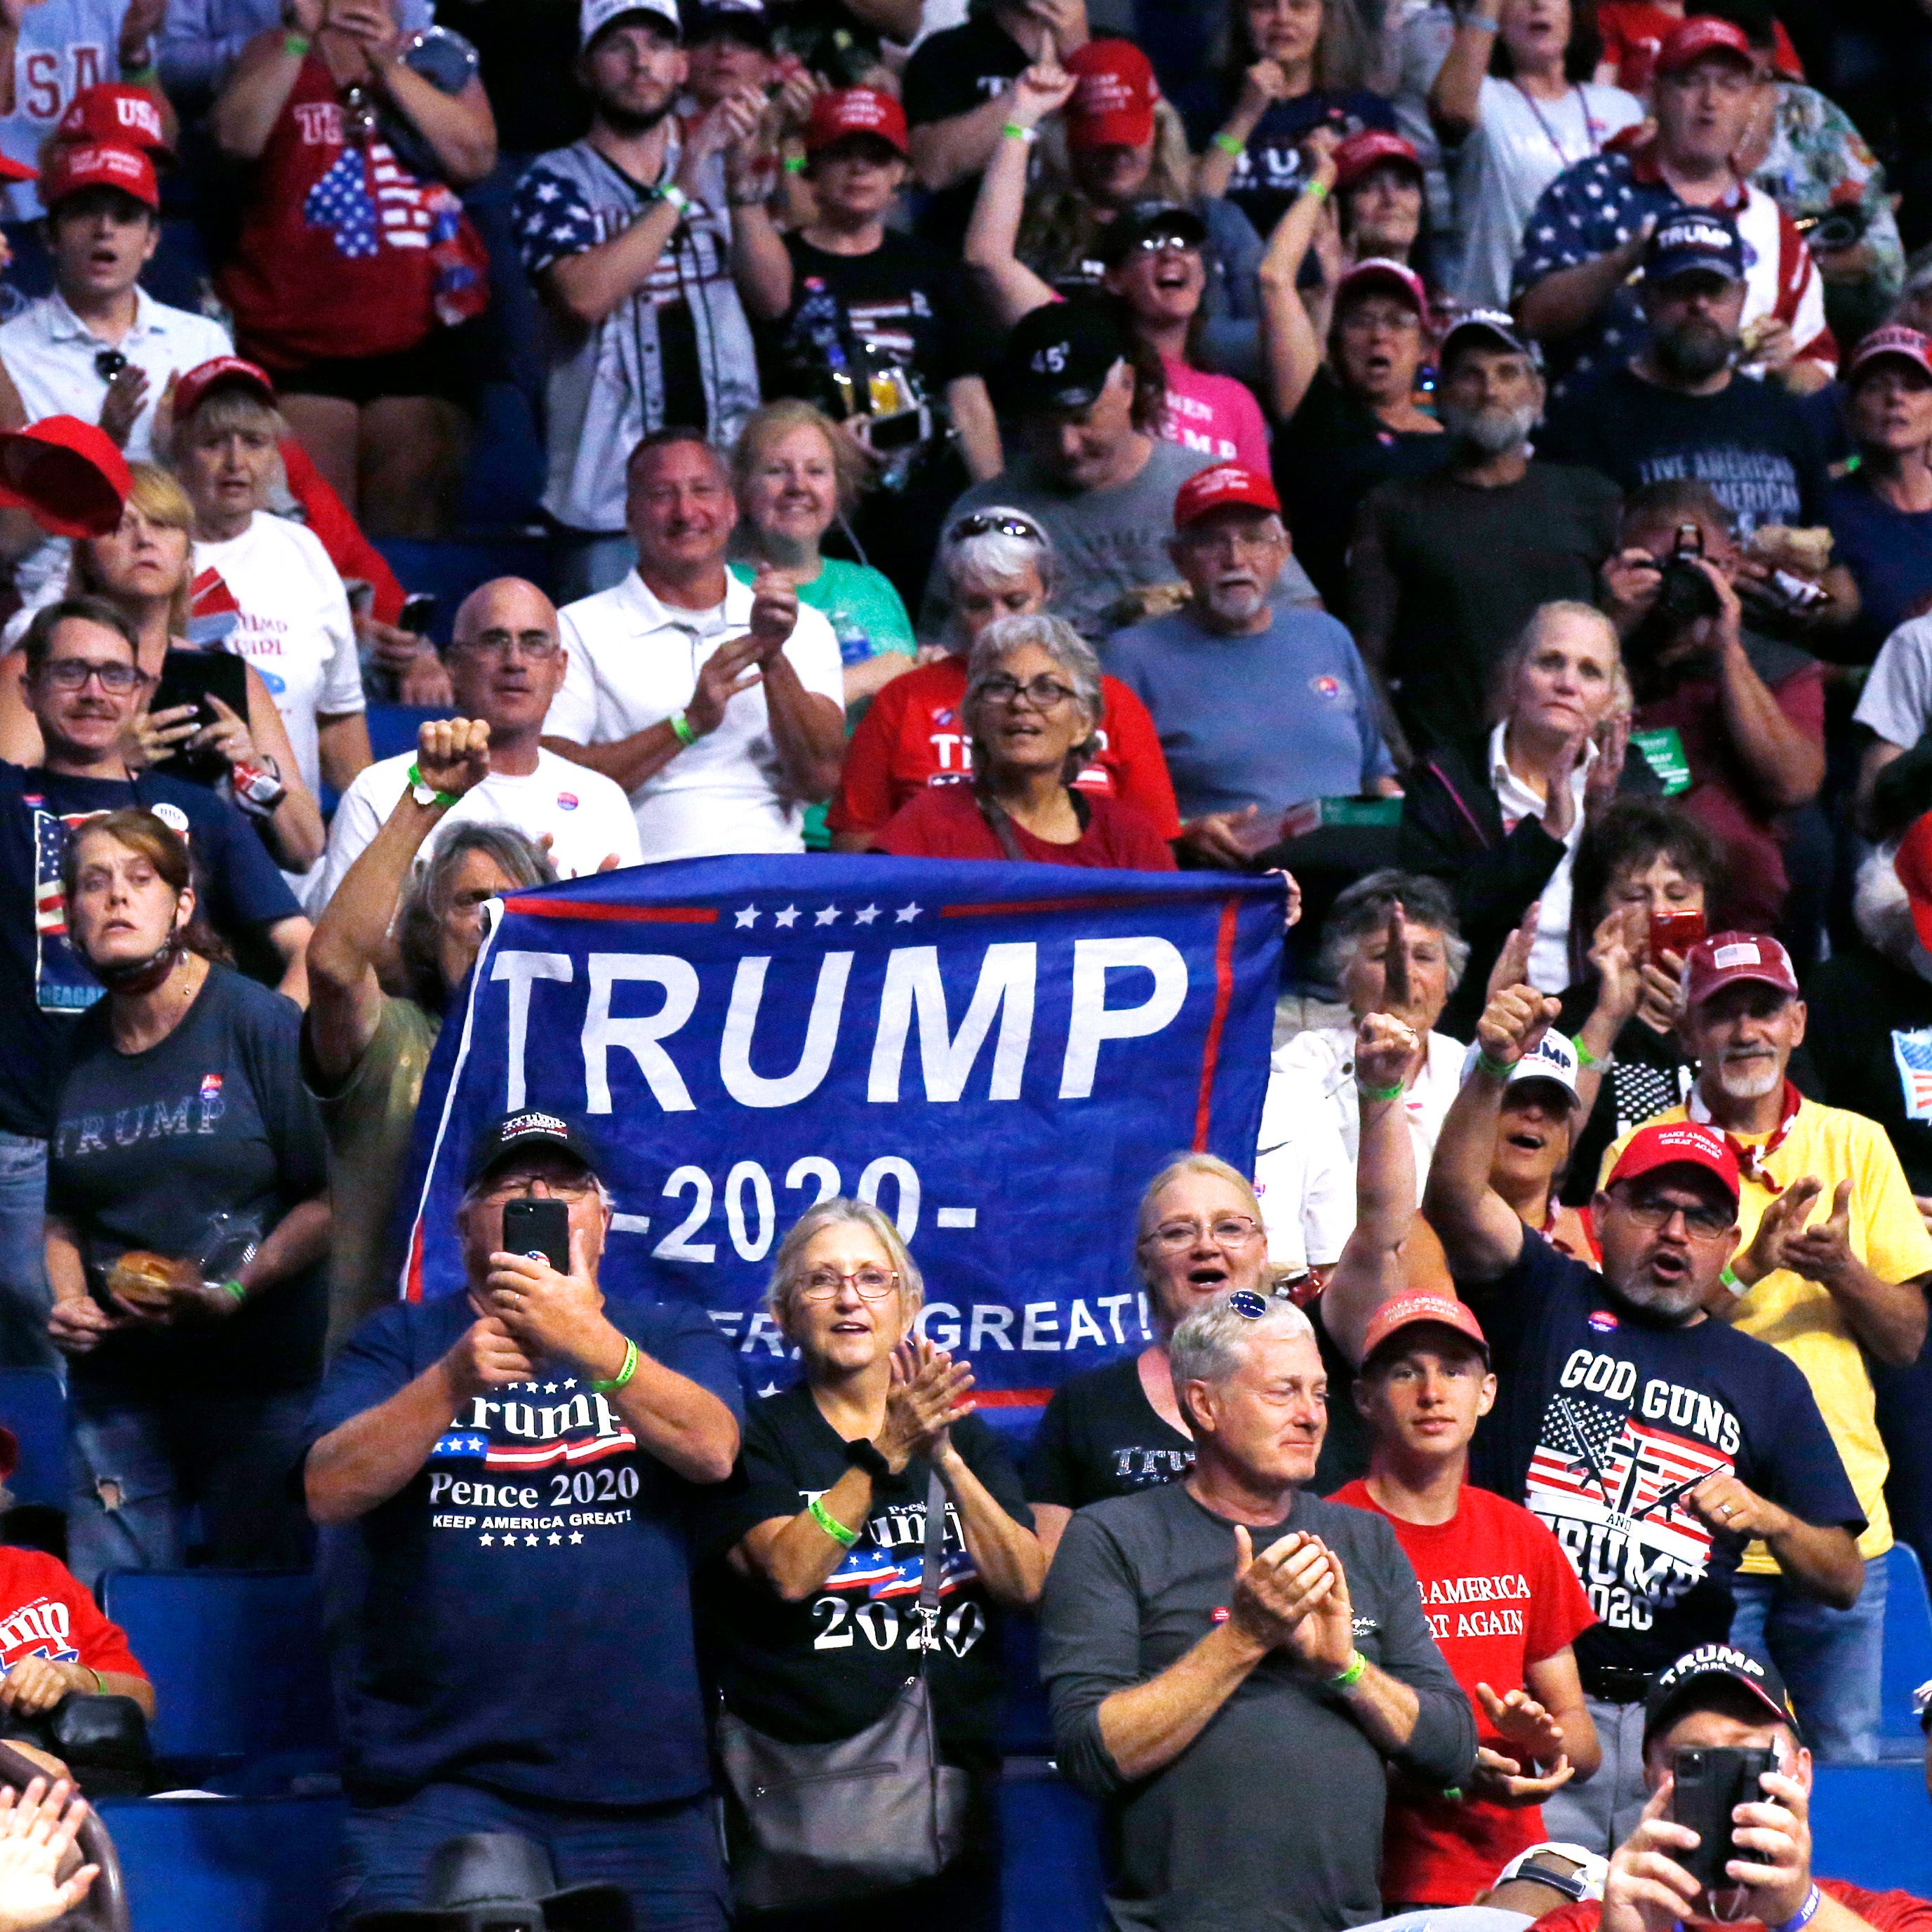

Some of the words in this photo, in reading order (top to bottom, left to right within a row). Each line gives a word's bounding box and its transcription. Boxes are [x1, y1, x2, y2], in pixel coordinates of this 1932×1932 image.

[489, 935, 1189, 1114] TRUMP
[55, 1096, 225, 1159] TRUMP
[1658, 1131, 1685, 1140] MAKE
[1686, 1132, 1724, 1156] AMERICA
[1694, 1142, 1721, 1160] AGAIN
[912, 1291, 1154, 1354] GREAT!
[1413, 1297, 1459, 1314] AMERICA
[450, 1392, 621, 1439] rump
[1559, 1348, 1637, 1411] GOD,
[1641, 1378, 1741, 1455] GUNS
[428, 1473, 539, 1509] Pence
[549, 1467, 640, 1507] 2020
[432, 1514, 477, 1529] KEEP
[481, 1516, 565, 1529] AMERICA
[568, 1510, 632, 1527] GREAT!
[1605, 1513, 1632, 1532] AND
[1429, 1574, 1532, 1604] AMERICA
[1578, 1579, 1653, 1631] 020
[812, 1597, 986, 1658] 2020
[1456, 1609, 1524, 1637] AGAIN
[1659, 1644, 1765, 1685] TRUMP
